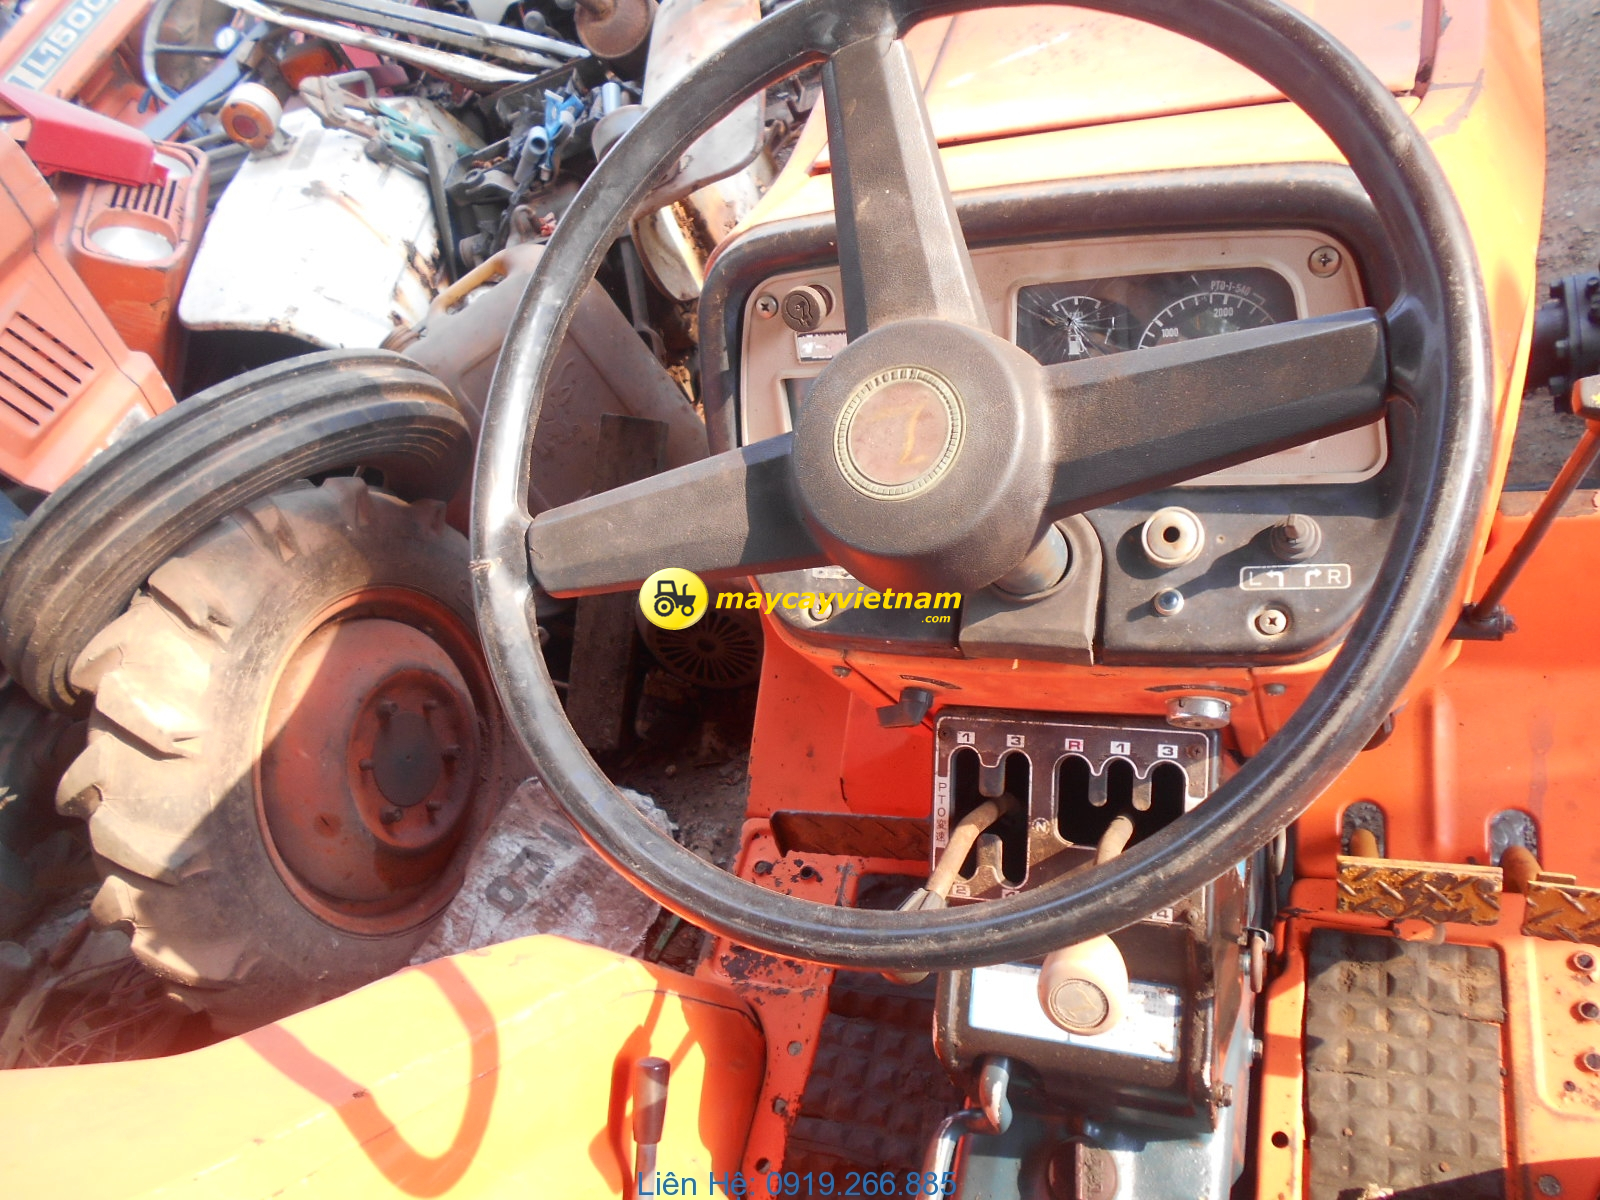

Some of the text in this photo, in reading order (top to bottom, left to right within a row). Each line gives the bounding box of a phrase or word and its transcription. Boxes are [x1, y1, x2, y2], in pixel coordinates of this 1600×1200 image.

[1213, 307, 1234, 317] 2000
[1161, 327, 1179, 338] 1000
[1249, 569, 1341, 586] L R
[1010, 736, 1021, 746] 3
[1068, 740, 1081, 750] R
[1162, 746, 1174, 756] 3
